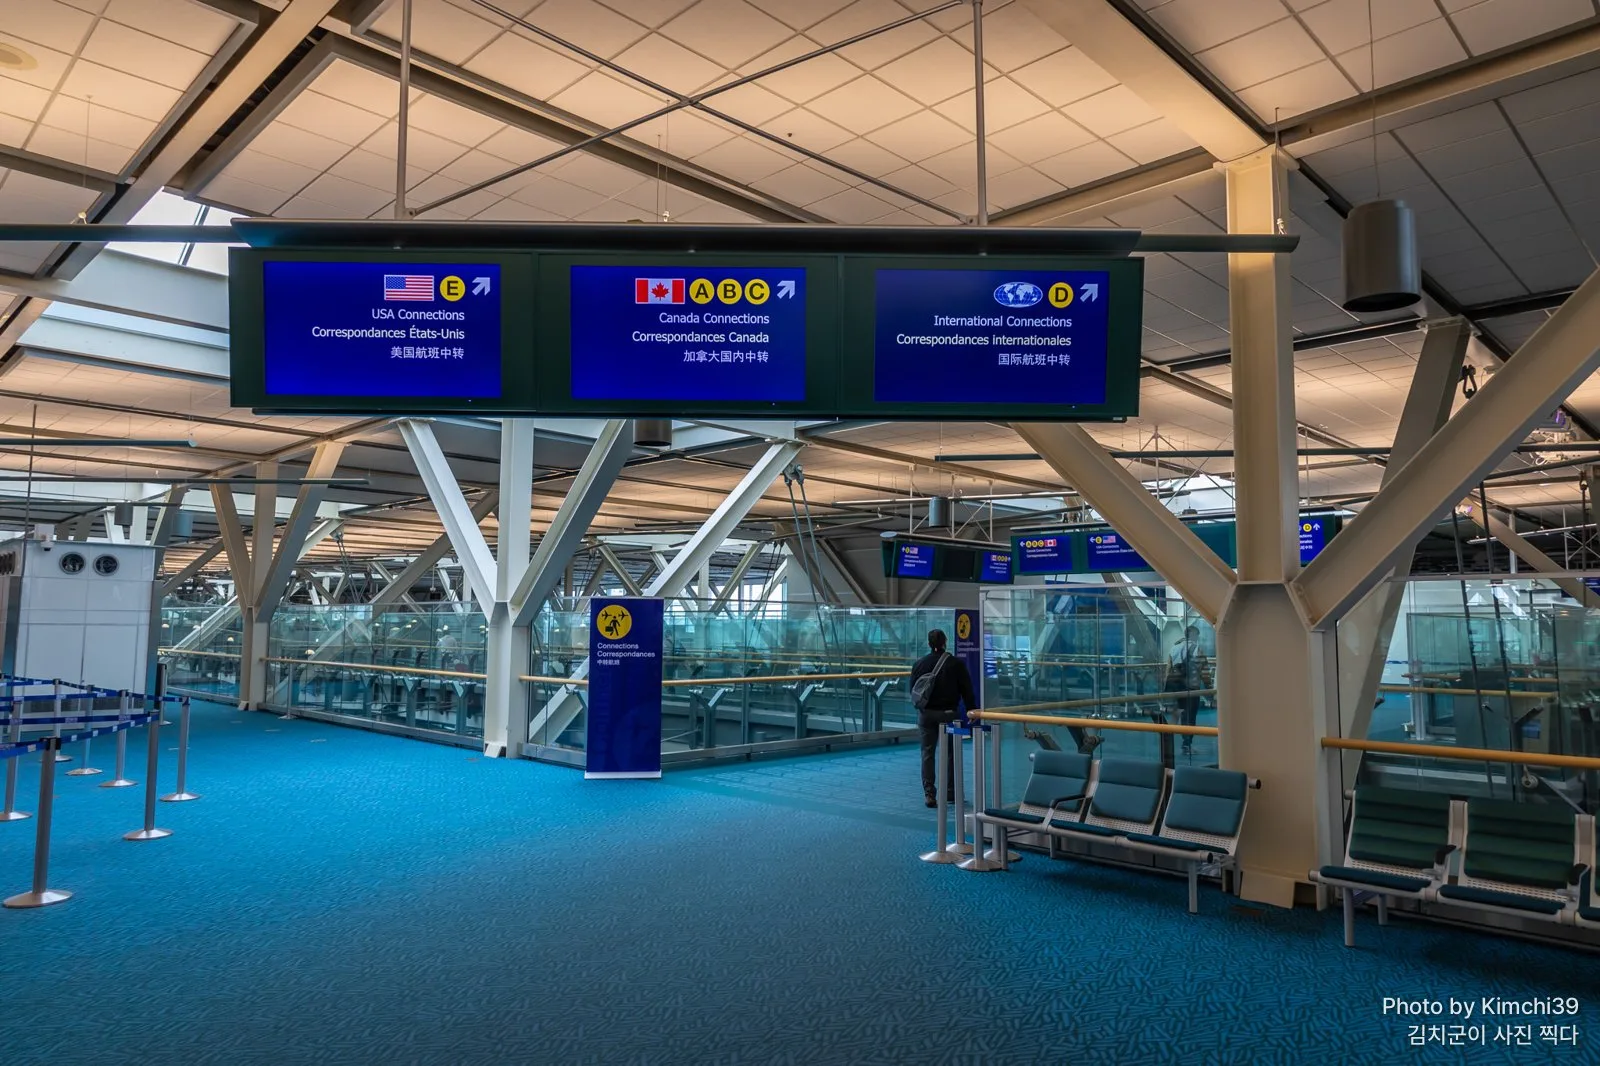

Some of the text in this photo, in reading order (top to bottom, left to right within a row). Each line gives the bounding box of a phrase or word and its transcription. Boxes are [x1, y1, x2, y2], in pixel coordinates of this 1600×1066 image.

[446, 280, 459, 296] E
[694, 282, 765, 300] A B C
[1054, 287, 1069, 303] D
[372, 308, 465, 320] USA Connections
[659, 312, 770, 324] Canada Connections
[934, 315, 1072, 327] International Connections
[312, 325, 465, 340] Correspondances États-Unis
[632, 331, 769, 344] Correspondances Canada
[896, 333, 1072, 347] Correspondances internationales
[390, 346, 464, 359] 美国航班中转
[683, 350, 769, 363] 加拿大国内中转
[998, 353, 1071, 366] 国际航班中转
[597, 642, 639, 650] Connections
[597, 650, 656, 658] Correspondances
